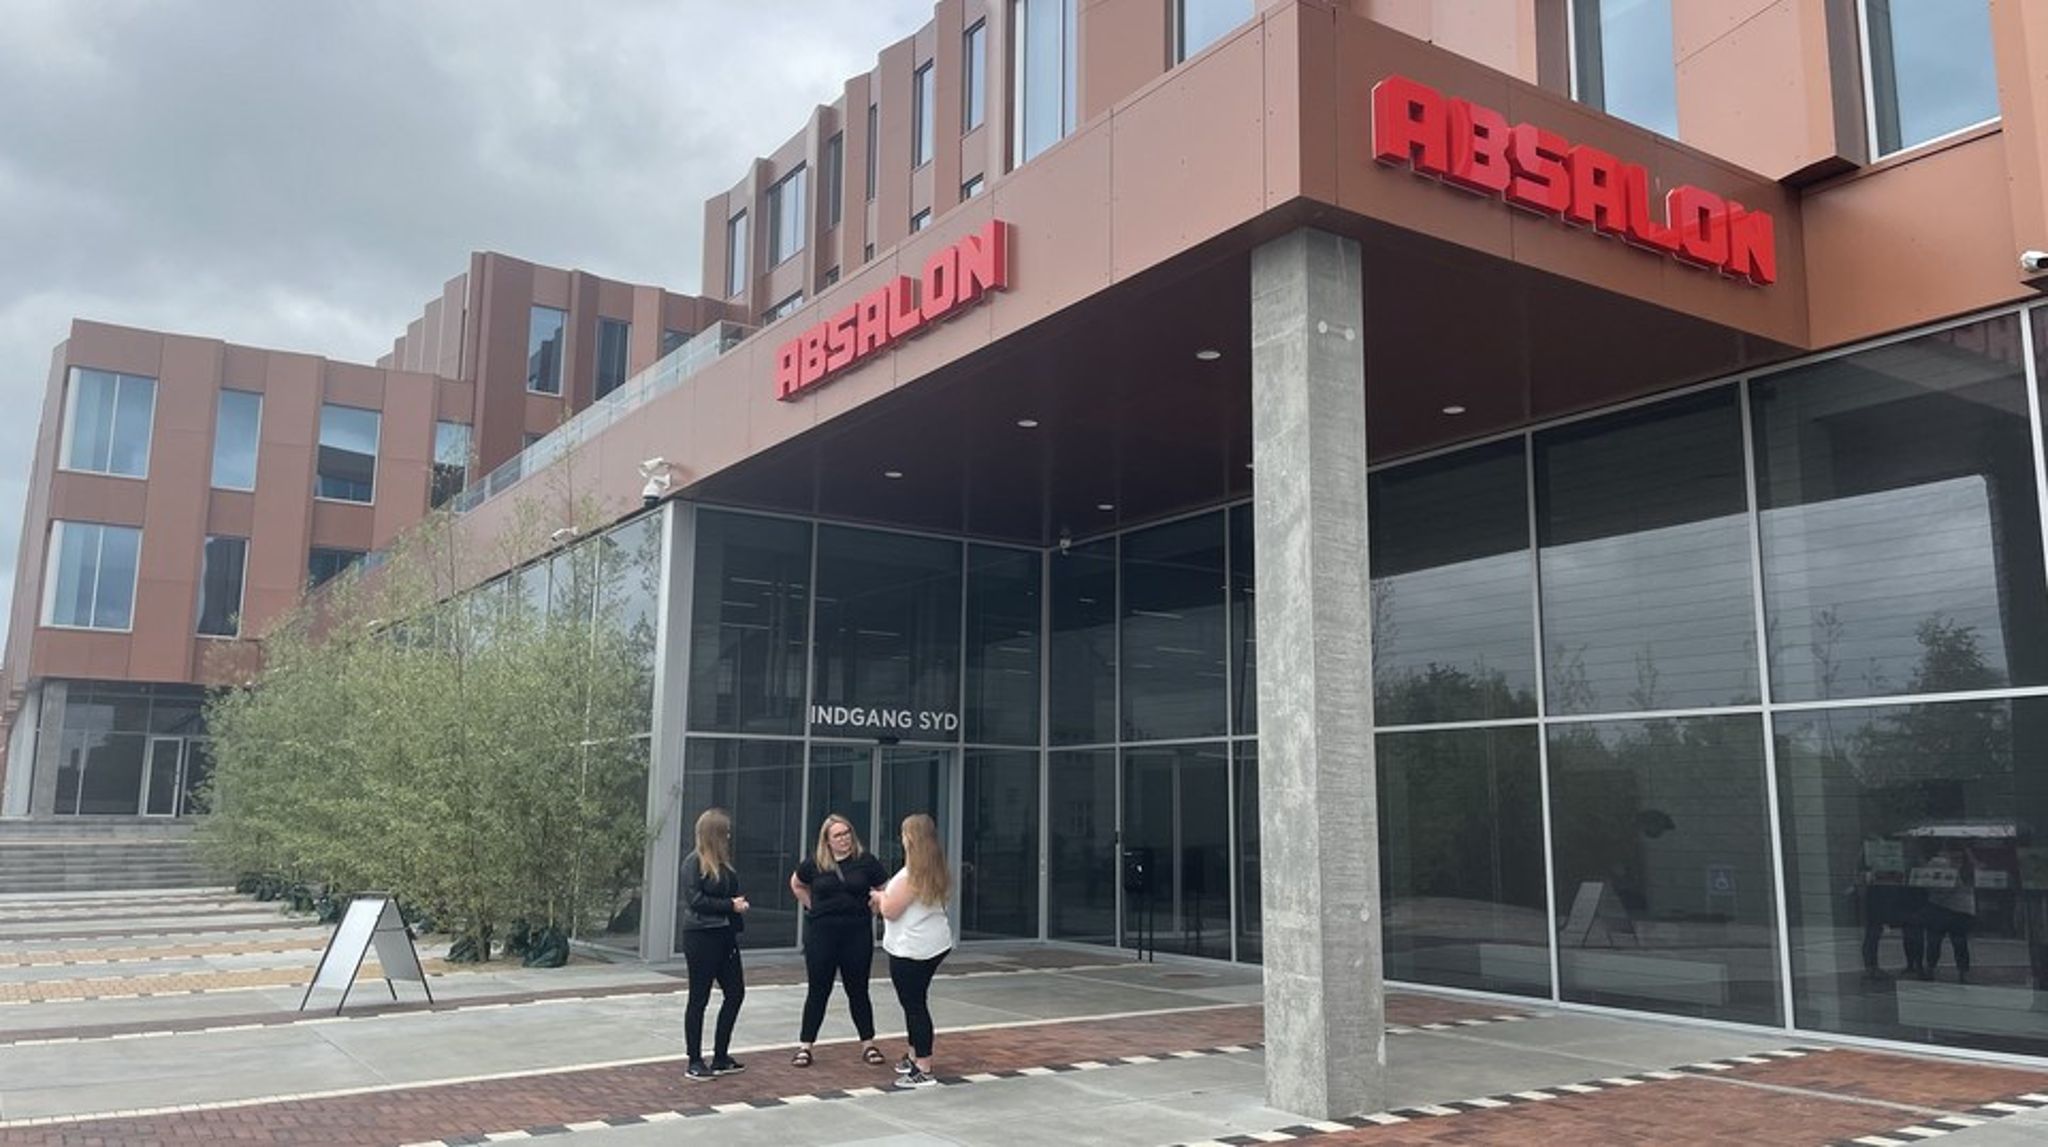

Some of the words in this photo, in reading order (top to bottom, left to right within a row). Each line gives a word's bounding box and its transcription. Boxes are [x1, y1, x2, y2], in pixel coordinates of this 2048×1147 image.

[1372, 75, 1776, 285] ABSALON
[776, 219, 1008, 400] ABSALON
[810, 705, 912, 728] INDGANG
[919, 711, 958, 730] SYD
